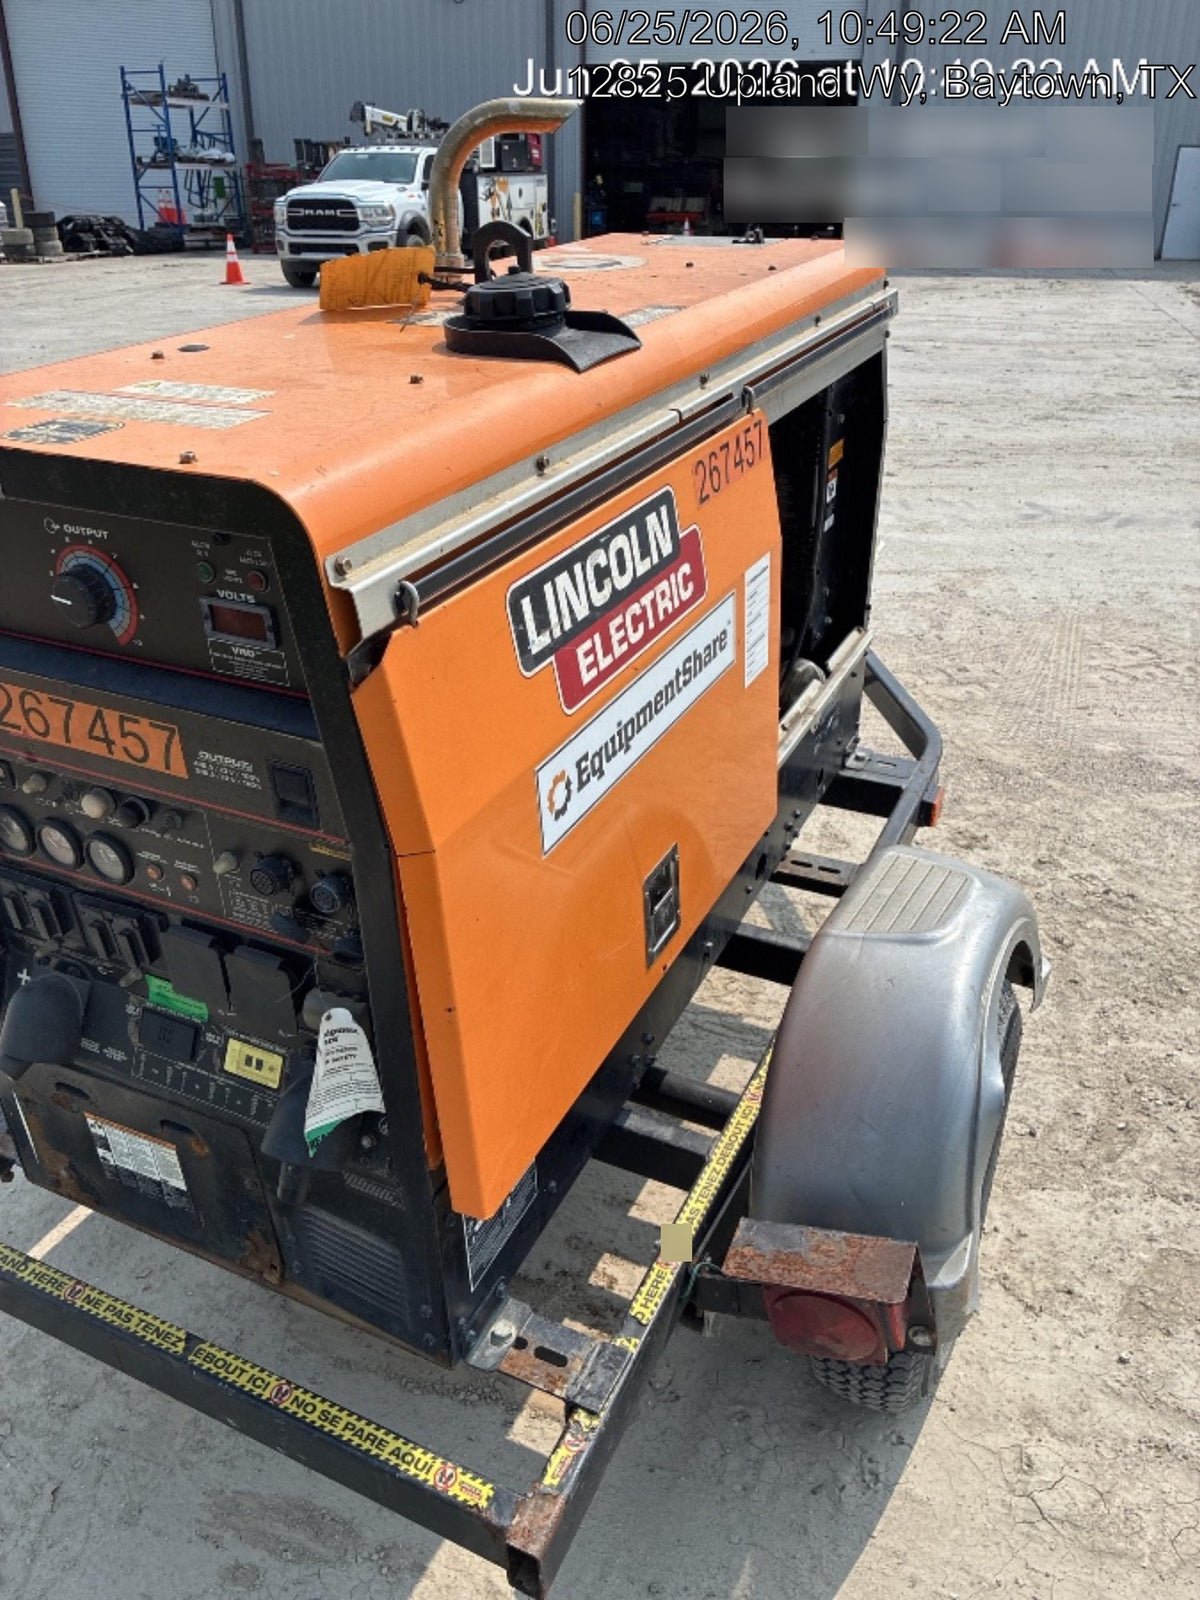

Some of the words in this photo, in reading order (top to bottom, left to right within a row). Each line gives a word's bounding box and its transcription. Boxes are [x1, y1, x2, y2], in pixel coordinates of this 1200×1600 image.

[304, 208, 336, 217] RAM
[694, 418, 762, 505] 267457
[62, 523, 110, 540] OUTPUT
[216, 589, 257, 604] VOLTS
[520, 504, 674, 656] LINCOLN
[574, 561, 695, 687] ELECTRIC
[0, 682, 177, 771] 267457
[574, 628, 729, 794] EquipmentShare
[695, 1167, 722, 1206] TENEZ
[715, 1120, 747, 1167] DEBOUT
[741, 1103, 755, 1121] ICI
[28, 1268, 68, 1292] HERE
[640, 1268, 668, 1310] HERE
[82, 1293, 105, 1311] NE
[104, 1304, 136, 1325] PAS
[135, 1318, 184, 1347] TENEZ
[246, 1373, 271, 1393] ICI
[290, 1394, 317, 1416] NO
[317, 1408, 343, 1430] SE
[342, 1420, 390, 1453] PARE
